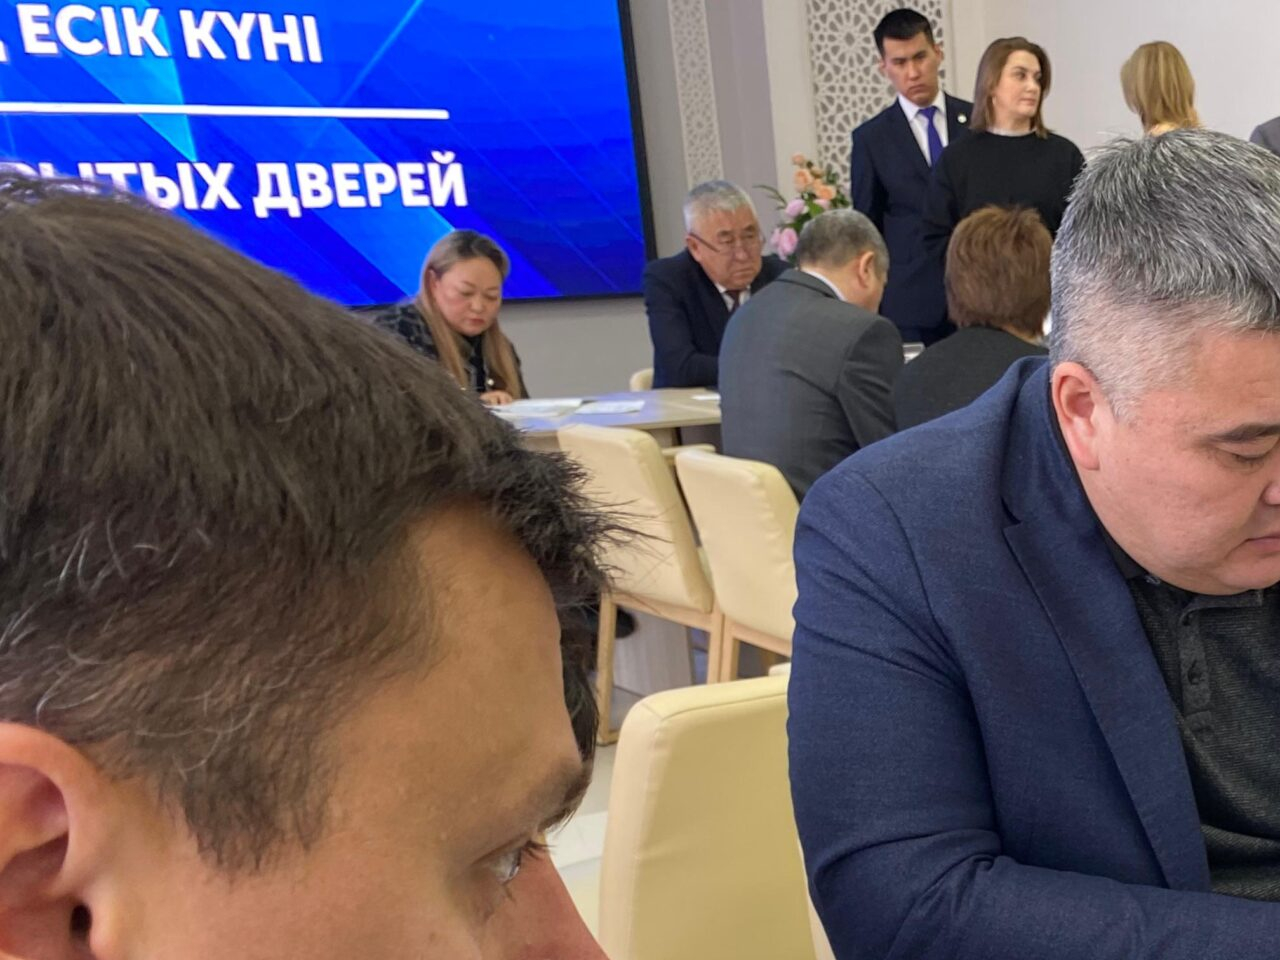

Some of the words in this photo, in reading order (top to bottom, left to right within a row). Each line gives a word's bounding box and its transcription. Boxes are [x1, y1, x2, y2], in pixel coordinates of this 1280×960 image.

[16, 3, 169, 57] ЕСІК
[180, 9, 323, 63] КҮНІ
[253, 152, 468, 218] ДВЕРЕЙ
